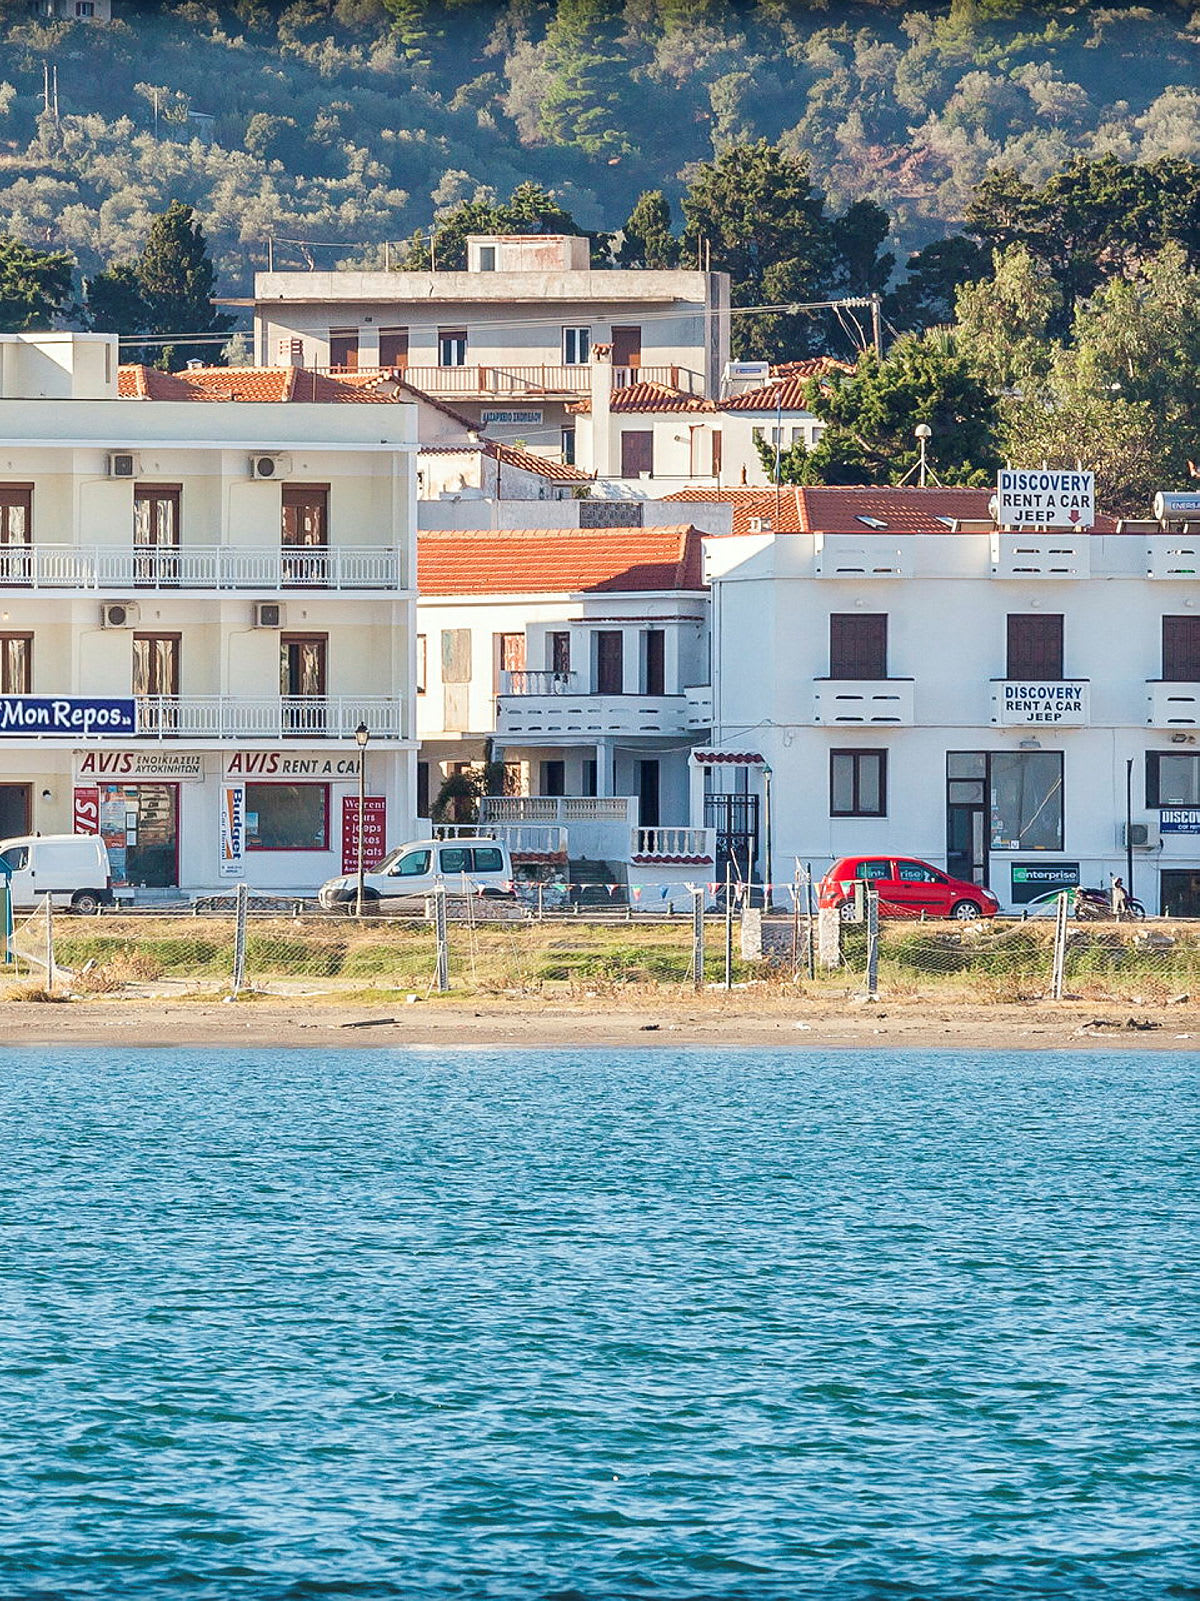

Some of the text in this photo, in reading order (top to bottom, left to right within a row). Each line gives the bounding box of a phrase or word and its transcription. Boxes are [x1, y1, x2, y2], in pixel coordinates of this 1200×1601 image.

[1002, 474, 1090, 491] DISCOVERY
[1003, 494, 1090, 508] RENT A CAR
[1014, 511, 1055, 521] JEEP
[1005, 687, 1082, 699] DISCOVERY
[1006, 701, 1082, 711] RENT A CAR
[1027, 713, 1062, 721] JEEP
[81, 753, 134, 773] AVIS
[137, 756, 200, 764] ΕΝΟΙΚΙΑΣΕΙΣ
[227, 753, 281, 773] AVIS
[283, 760, 319, 773] RENT
[322, 760, 332, 773] A
[135, 765, 199, 773] ΑΥΤΟΚΙΝΗΤΩΝ
[364, 801, 385, 809] rent
[232, 789, 242, 860] Budget
[352, 836, 380, 844] bkes
[1016, 870, 1077, 880] enterprise
